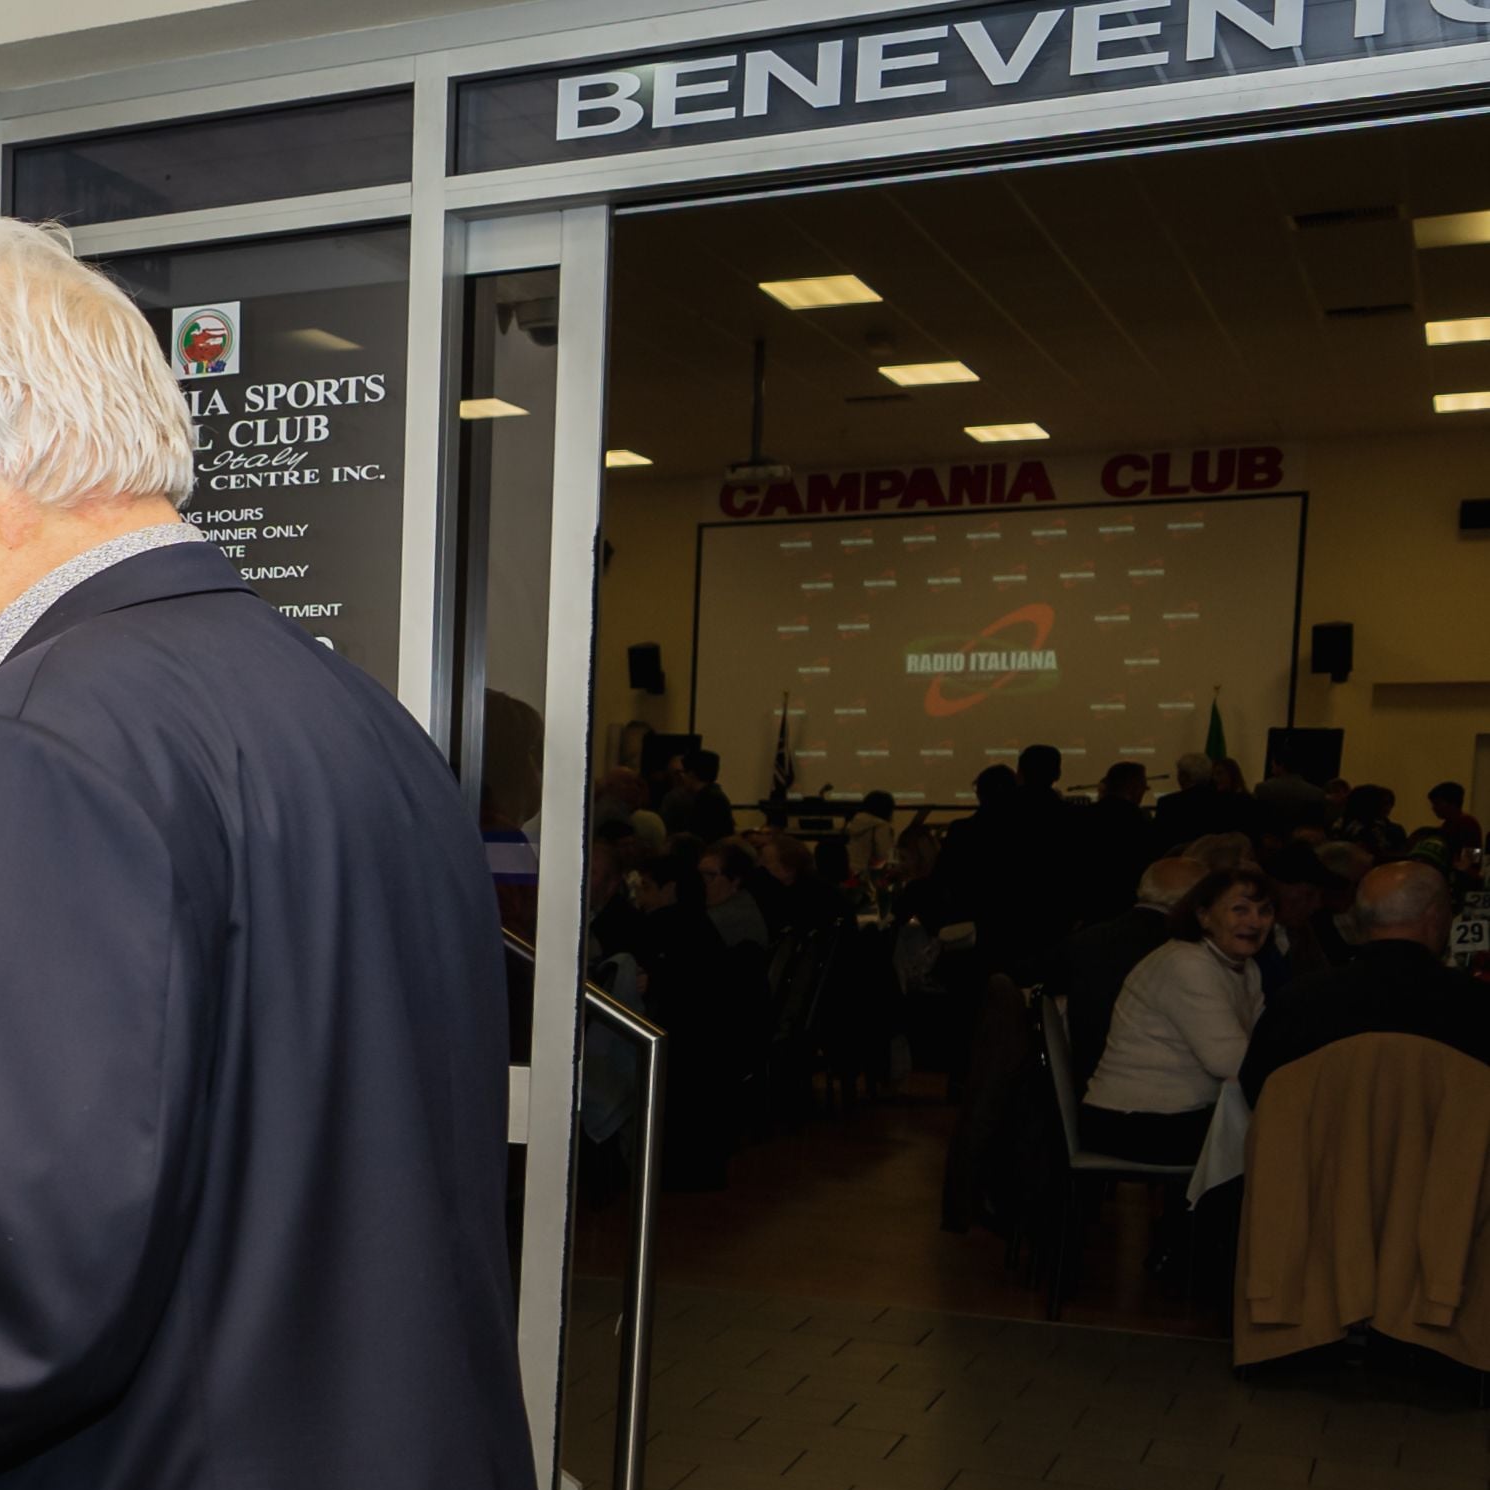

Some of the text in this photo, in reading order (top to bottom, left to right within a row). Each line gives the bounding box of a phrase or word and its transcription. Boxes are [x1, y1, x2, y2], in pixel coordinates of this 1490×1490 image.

[556, 0, 1490, 141] BENEVEN
[244, 374, 386, 413] SPORTS
[228, 414, 330, 448] CLUB
[198, 446, 309, 472] Italy
[210, 468, 320, 490] CENTRE
[331, 464, 386, 483] INC.
[720, 446, 1285, 518] CAMPANIA CLUB
[207, 507, 264, 523] HOURS
[202, 524, 309, 543] DINNER ONLY
[240, 565, 310, 580] SUNDAY
[906, 650, 1059, 674] RADIO ITALIANA
[1456, 923, 1484, 944] 29
